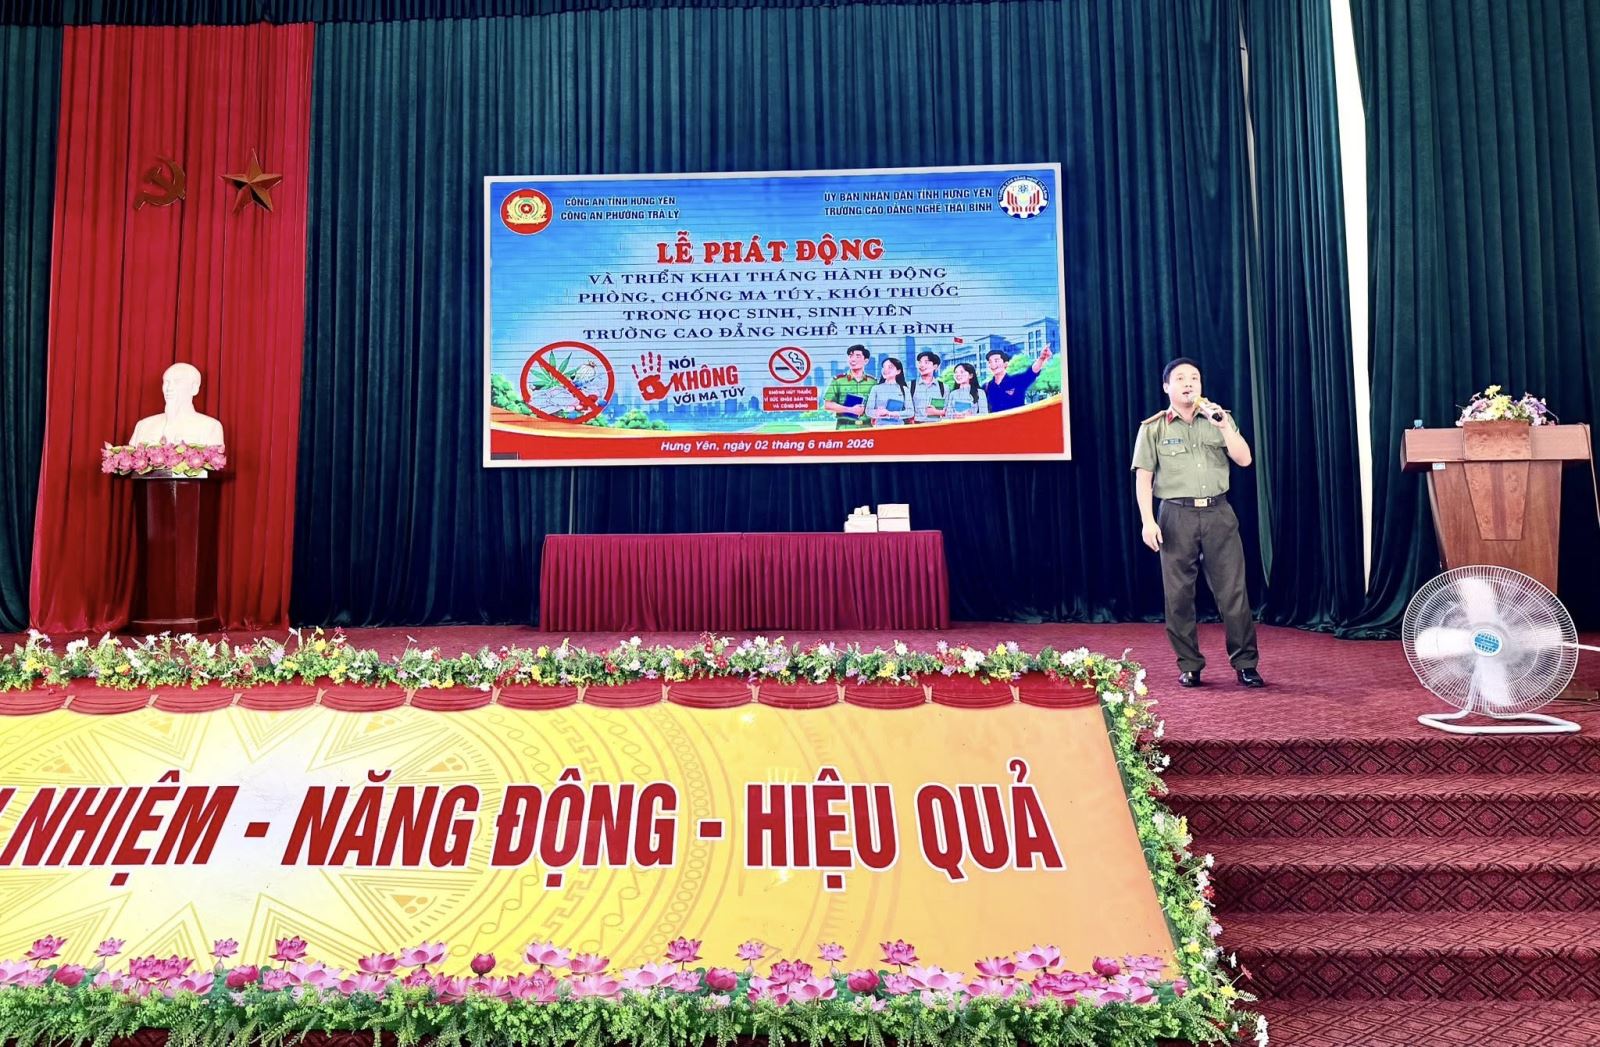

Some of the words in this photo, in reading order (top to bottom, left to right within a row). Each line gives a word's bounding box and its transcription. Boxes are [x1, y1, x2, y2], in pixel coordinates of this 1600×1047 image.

[565, 196, 590, 206] CÔNG
[592, 197, 605, 206] AN
[839, 190, 860, 202] BAN
[943, 188, 970, 198] HƯNG
[973, 187, 993, 198] YÊN
[560, 209, 587, 220] CÔNG
[589, 211, 603, 220] AN
[647, 209, 666, 219] TRÀ
[668, 208, 680, 219] LÝ
[865, 206, 884, 215] CAO
[944, 202, 966, 213] THÁI
[969, 201, 993, 212] BÌNH
[656, 230, 694, 264] LỄ
[703, 235, 787, 264] PHÁT
[795, 232, 885, 265] ĐỘNG
[589, 271, 615, 285] VÀ
[621, 269, 685, 284] TRIỂN
[691, 272, 741, 283] KHAI
[746, 269, 817, 283] THÁNG
[823, 267, 883, 280] HÀNH
[889, 266, 948, 281] ĐỘNG
[579, 290, 656, 303] PHÒNG,
[661, 288, 733, 302] CHỐNG
[739, 290, 768, 301] MA
[773, 287, 822, 301] TÚY,
[828, 286, 881, 299] KHÓI
[886, 282, 959, 298] THUỐC
[622, 309, 692, 321] TRONG
[697, 308, 741, 322] HỌC
[746, 308, 802, 320] SINH,
[808, 307, 857, 318] SINH
[862, 304, 913, 317] VIÊN
[583, 326, 667, 340] TRƯỜNG
[673, 328, 713, 339] CAO
[719, 323, 775, 338] ĐẲNG
[780, 321, 839, 337] NGHỀ
[845, 322, 897, 336] THÁI
[902, 321, 955, 335] BÌNH
[668, 355, 696, 370] NÓI
[672, 364, 739, 392] KHÔNG
[673, 392, 696, 405] VỚI
[698, 391, 719, 402] MA
[720, 386, 746, 399] TÚY
[660, 441, 692, 453] Hưng
[695, 440, 719, 452] Yên,
[723, 440, 751, 453] ngày
[754, 440, 769, 450] 02
[771, 440, 805, 452] tháng
[807, 440, 816, 450] 6
[818, 439, 844, 449] năm
[846, 439, 874, 449] 2026
[0, 769, 240, 886] NHIỆM
[244, 821, 270, 838] -
[281, 769, 480, 868] NĂNG
[491, 766, 677, 888] ĐỘNG
[699, 821, 722, 838] -
[745, 767, 897, 889] HIỆU
[917, 758, 1064, 880] QUẢ
